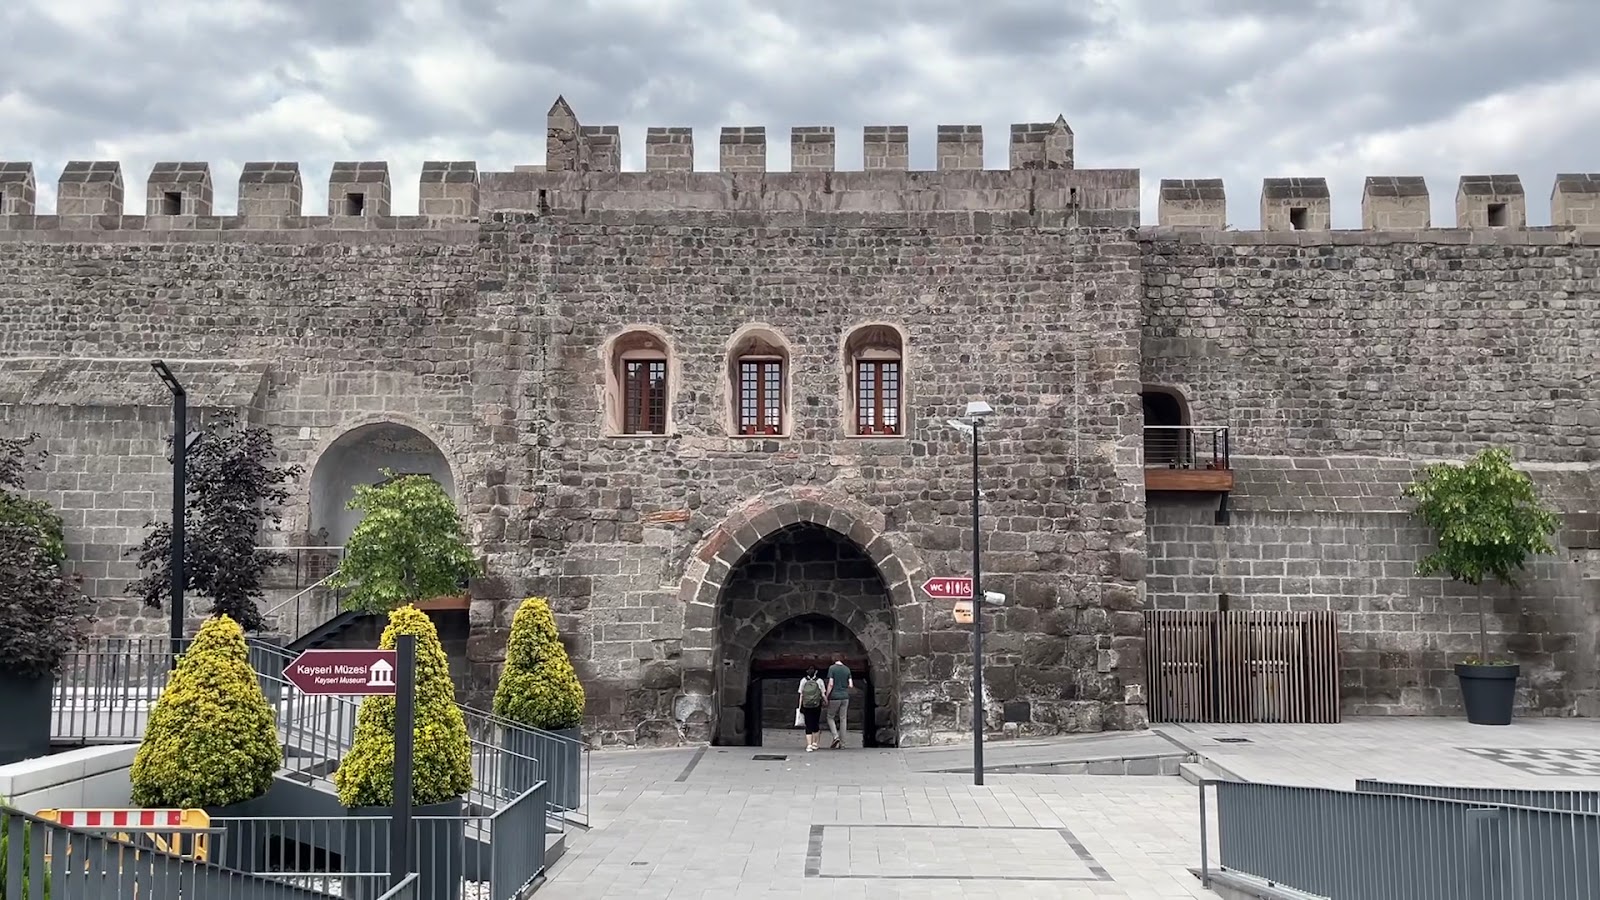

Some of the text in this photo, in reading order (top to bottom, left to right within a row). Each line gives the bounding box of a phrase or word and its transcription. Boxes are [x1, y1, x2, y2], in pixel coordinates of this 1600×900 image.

[297, 664, 367, 676] Kayseri Müzesi
[314, 676, 366, 685] Kayseri Museum
